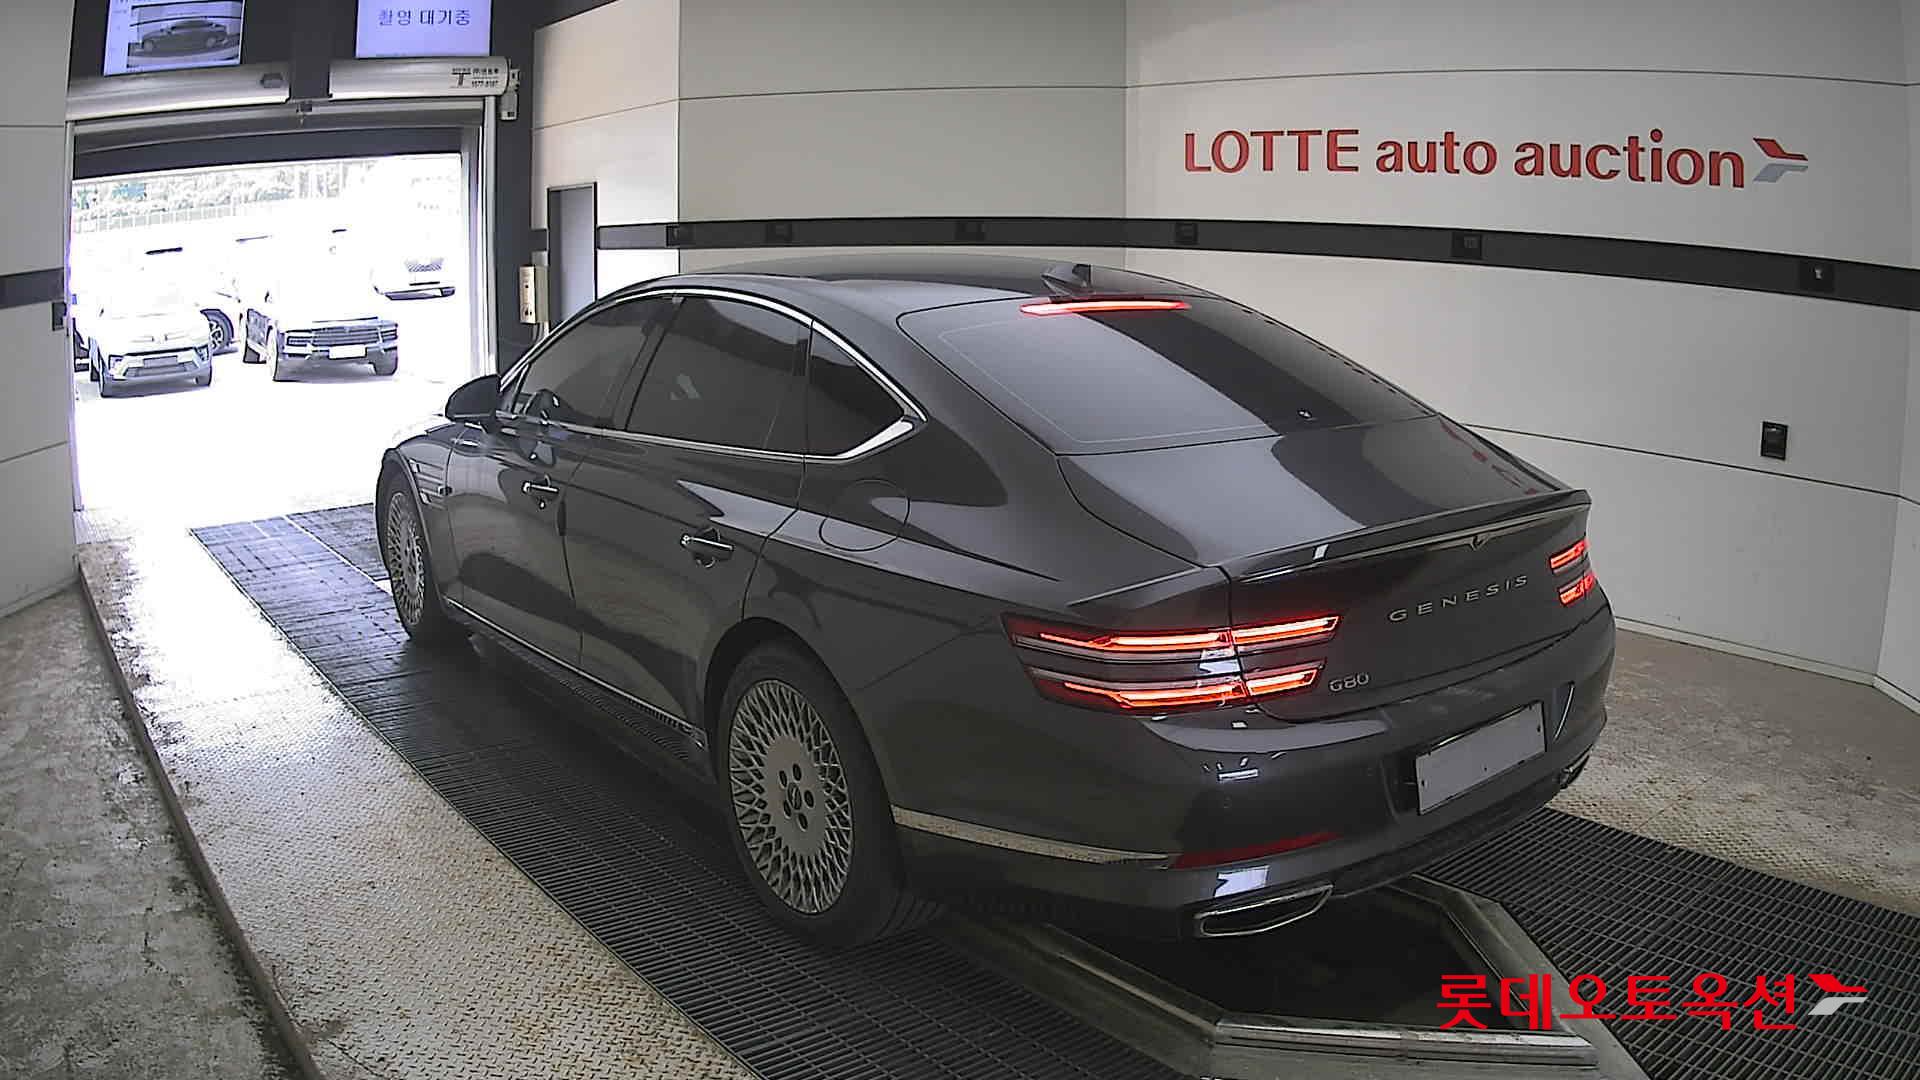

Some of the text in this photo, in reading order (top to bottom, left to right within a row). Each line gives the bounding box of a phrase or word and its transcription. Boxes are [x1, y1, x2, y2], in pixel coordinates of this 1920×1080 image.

[420, 9, 470, 26] 대기중
[1183, 129, 1745, 188] LOTTE auto auction
[1388, 574, 1528, 622] GENESIS
[1329, 672, 1370, 693] G80
